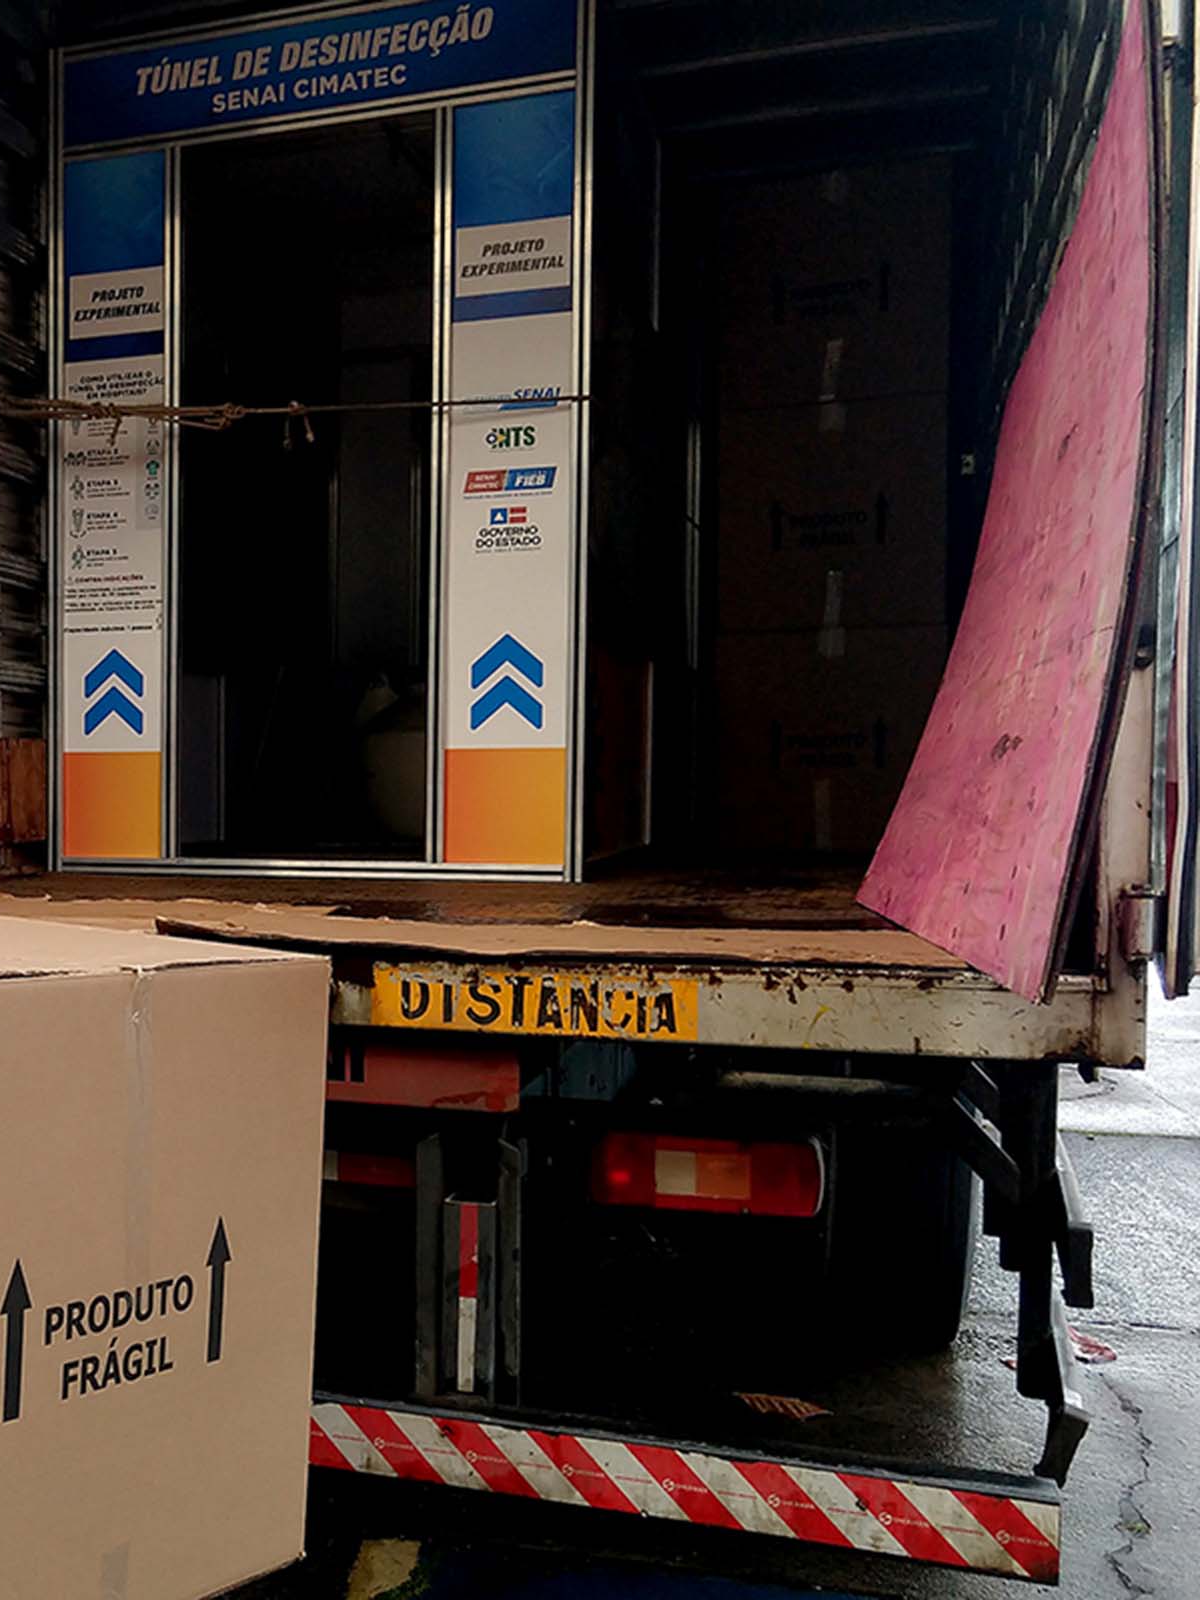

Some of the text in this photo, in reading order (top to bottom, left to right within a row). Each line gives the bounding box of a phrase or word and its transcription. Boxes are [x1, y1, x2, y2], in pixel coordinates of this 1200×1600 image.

[136, 4, 494, 95] TÚNEL DE DESINFECÇÃO
[212, 64, 407, 113] SENAI CIMATEC
[482, 238, 544, 257] PROJETO
[460, 255, 564, 278] EXPERIMENTAL
[91, 286, 144, 303] PROJETO
[73, 302, 161, 322] EXPERIMENTAL
[476, 535, 541, 549] DO ESTADO
[479, 525, 538, 538] GOVERNO
[43, 1274, 194, 1346] PRODUTO
[61, 1335, 174, 1400] FRÁGIL
